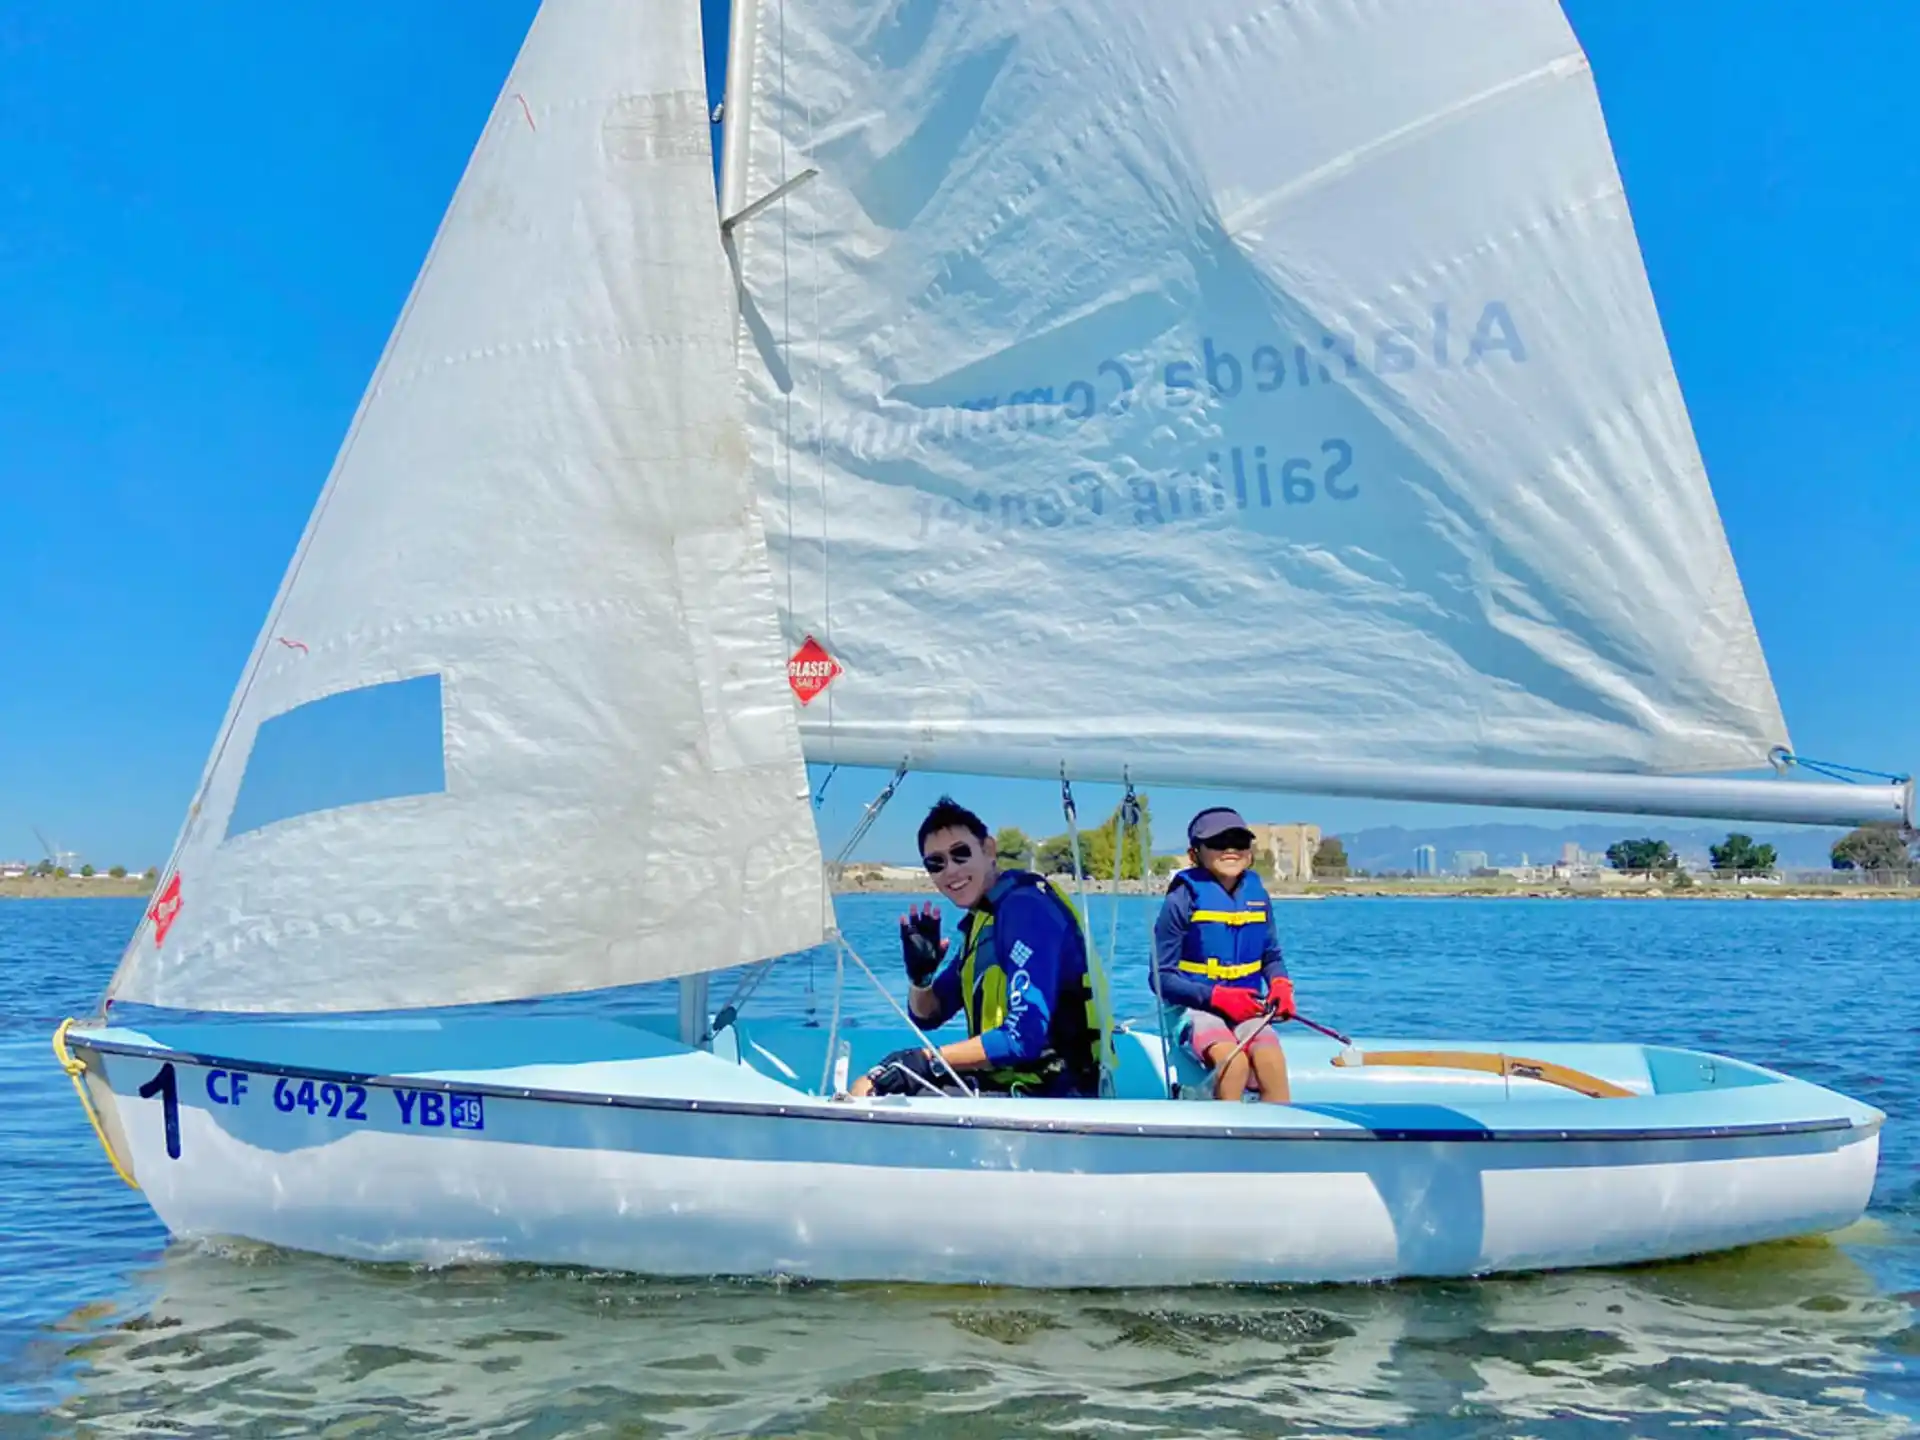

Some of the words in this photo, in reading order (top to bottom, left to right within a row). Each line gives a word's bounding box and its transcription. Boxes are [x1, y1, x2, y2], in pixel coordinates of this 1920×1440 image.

[139, 1062, 181, 1159] 1
[206, 1070, 248, 1105] CF
[273, 1078, 368, 1121] 6492
[394, 1089, 445, 1127] YB
